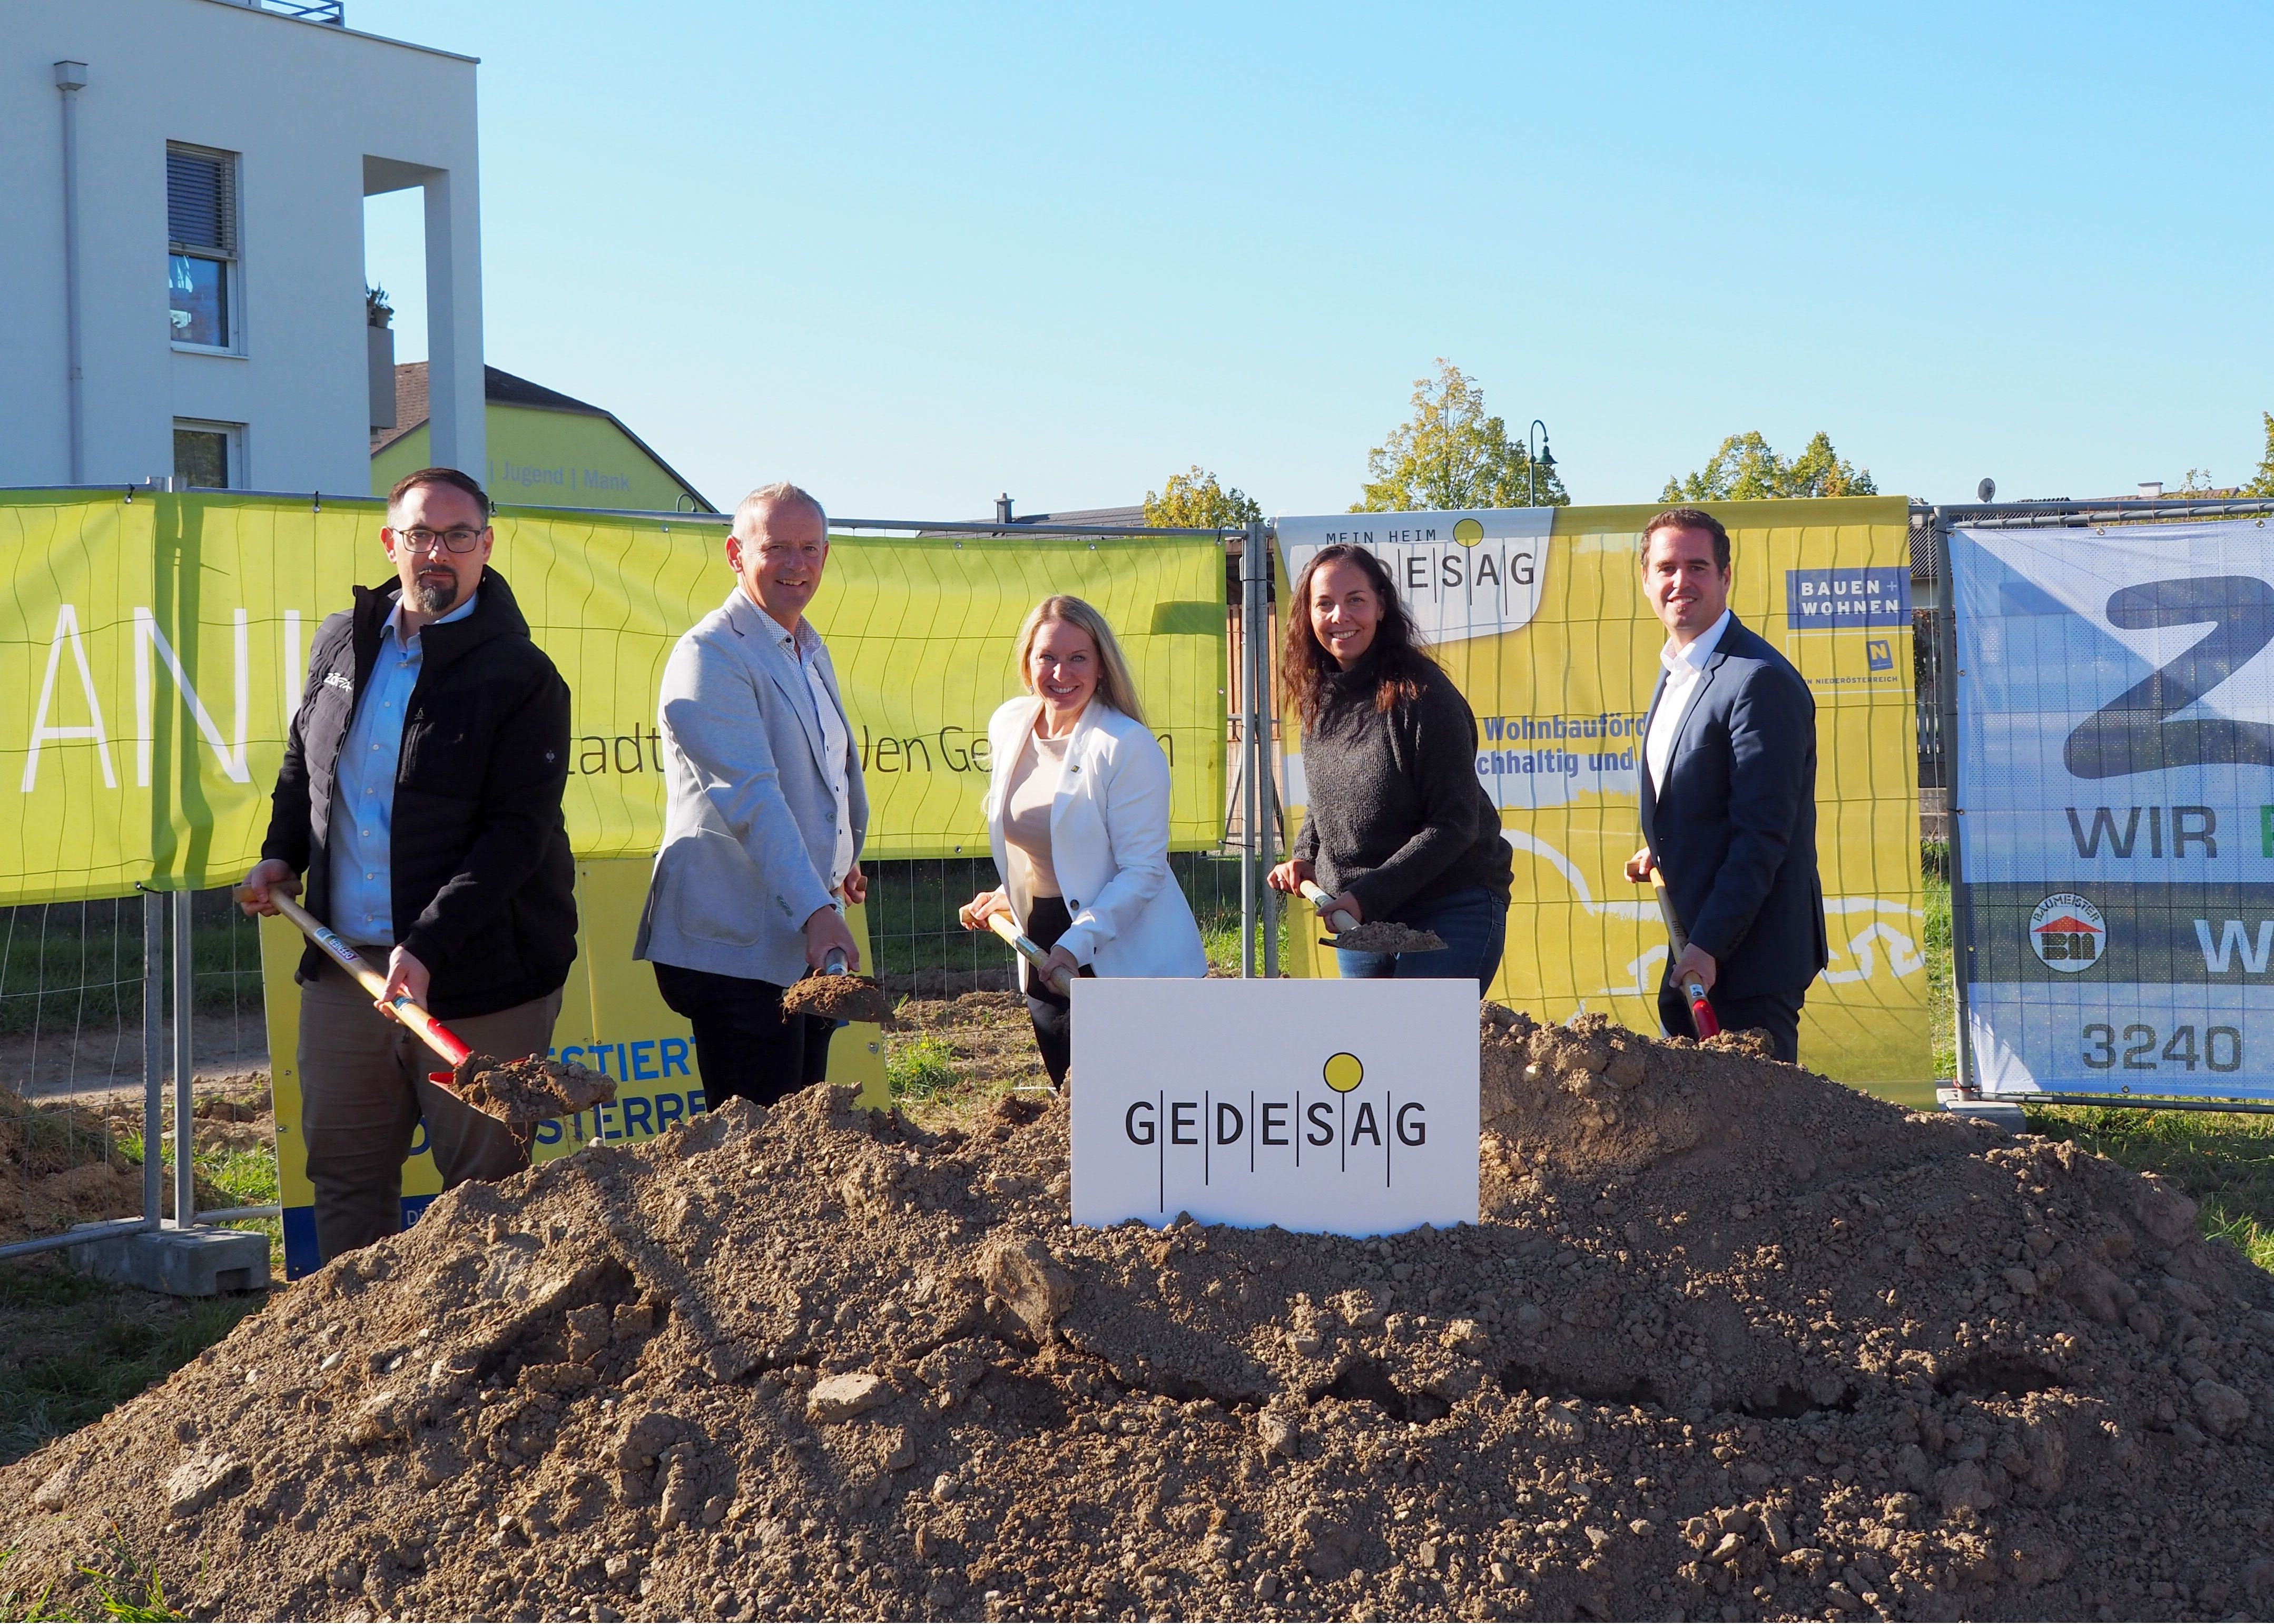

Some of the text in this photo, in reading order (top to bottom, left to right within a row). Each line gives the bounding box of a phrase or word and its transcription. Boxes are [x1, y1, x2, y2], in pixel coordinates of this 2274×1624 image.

[503, 460, 631, 491] Jugend Mank
[1326, 529, 1435, 545] MEIN HEIM
[1801, 580, 1879, 596] BAUEN
[1802, 599, 1898, 616] WOHNEN
[1816, 676, 1897, 684] NIEDERÖSTERREICH
[574, 722, 665, 774] adt
[1476, 746, 1633, 778] chhaltig und
[2065, 805, 2217, 858] WIR
[2033, 895, 2100, 922] BAUMEISTER
[2082, 1023, 2242, 1072] 3240
[1125, 1101, 1426, 1147] GEDESAG
